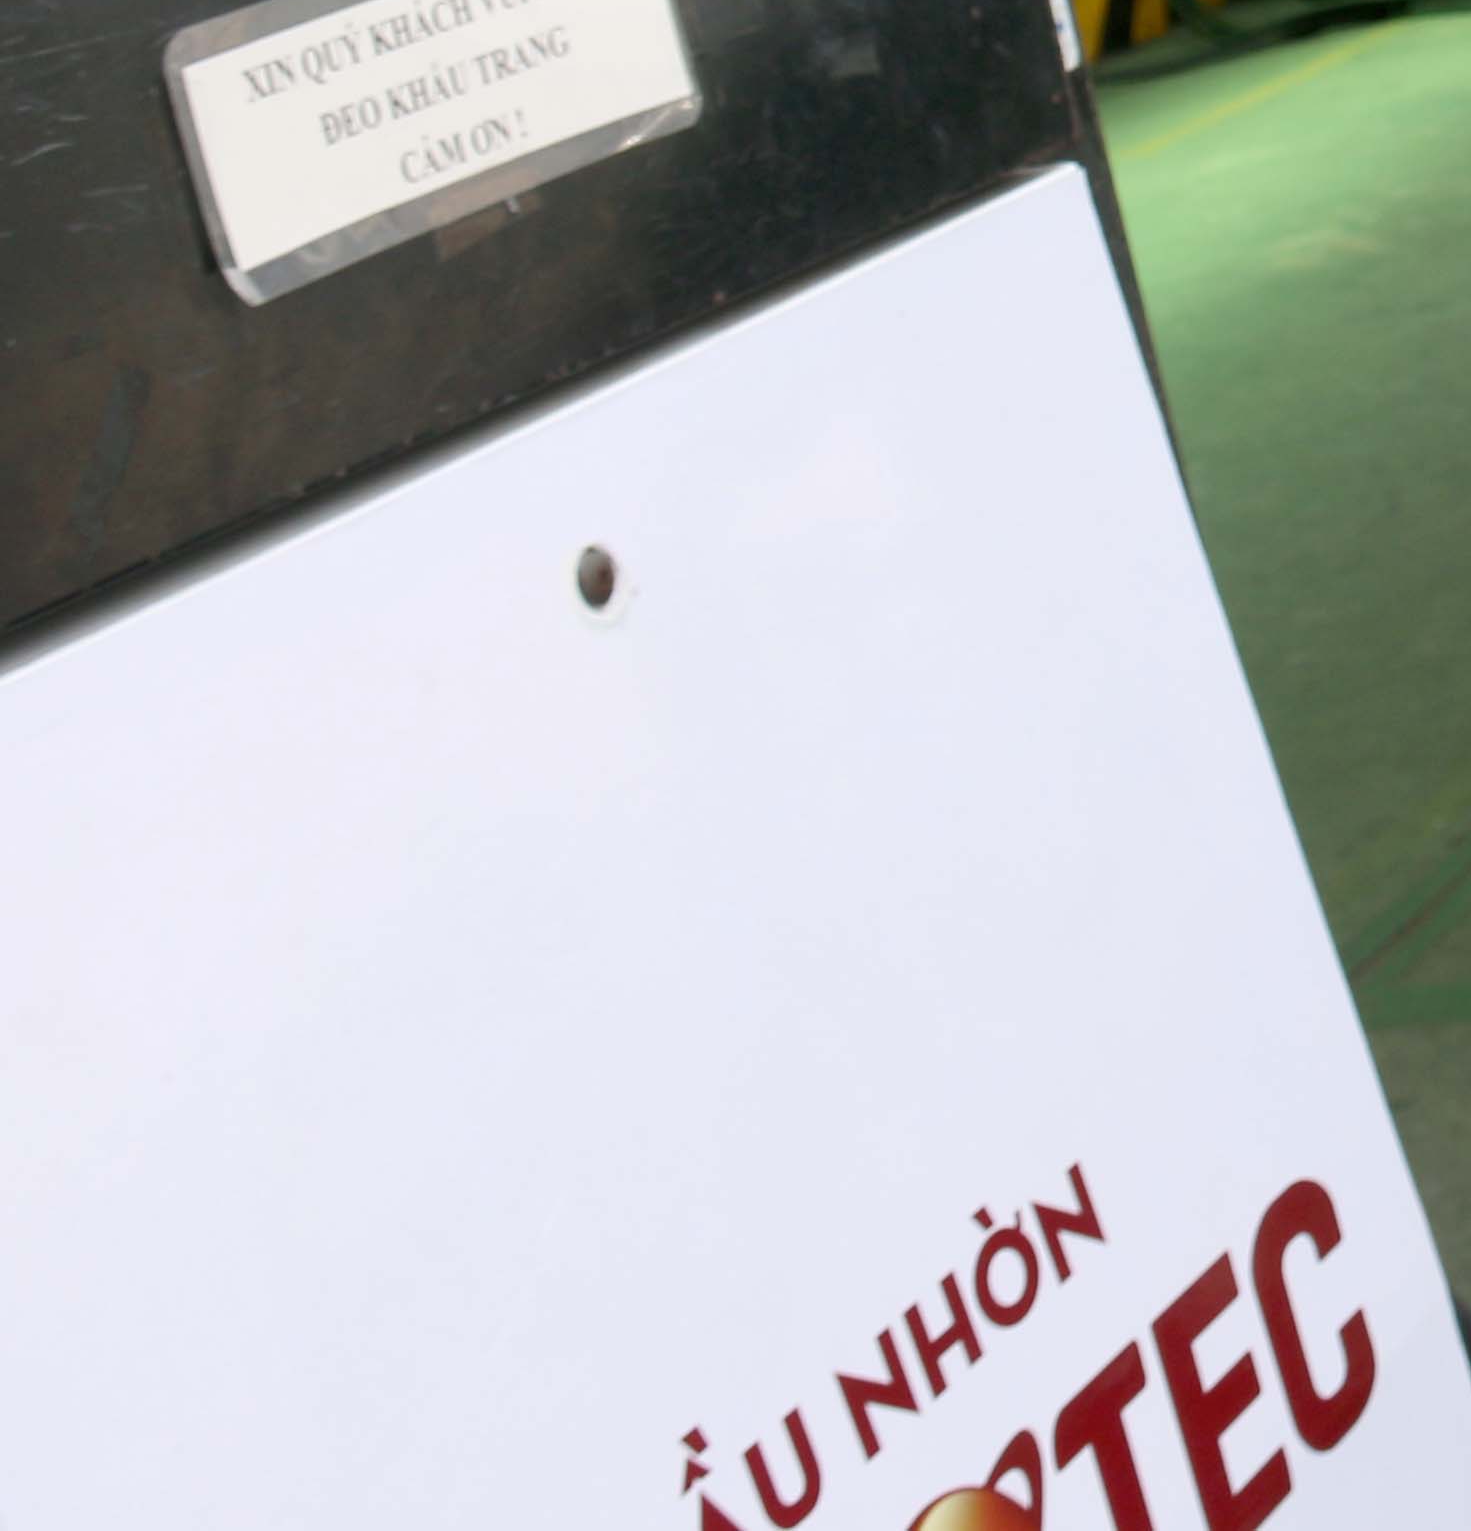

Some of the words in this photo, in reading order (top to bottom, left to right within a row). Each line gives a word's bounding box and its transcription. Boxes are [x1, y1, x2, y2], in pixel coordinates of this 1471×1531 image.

[242, 56, 297, 103] XIN
[318, 98, 382, 147] ĐEO
[475, 26, 571, 86] TRANG
[835, 1160, 1106, 1461] NHỜN
